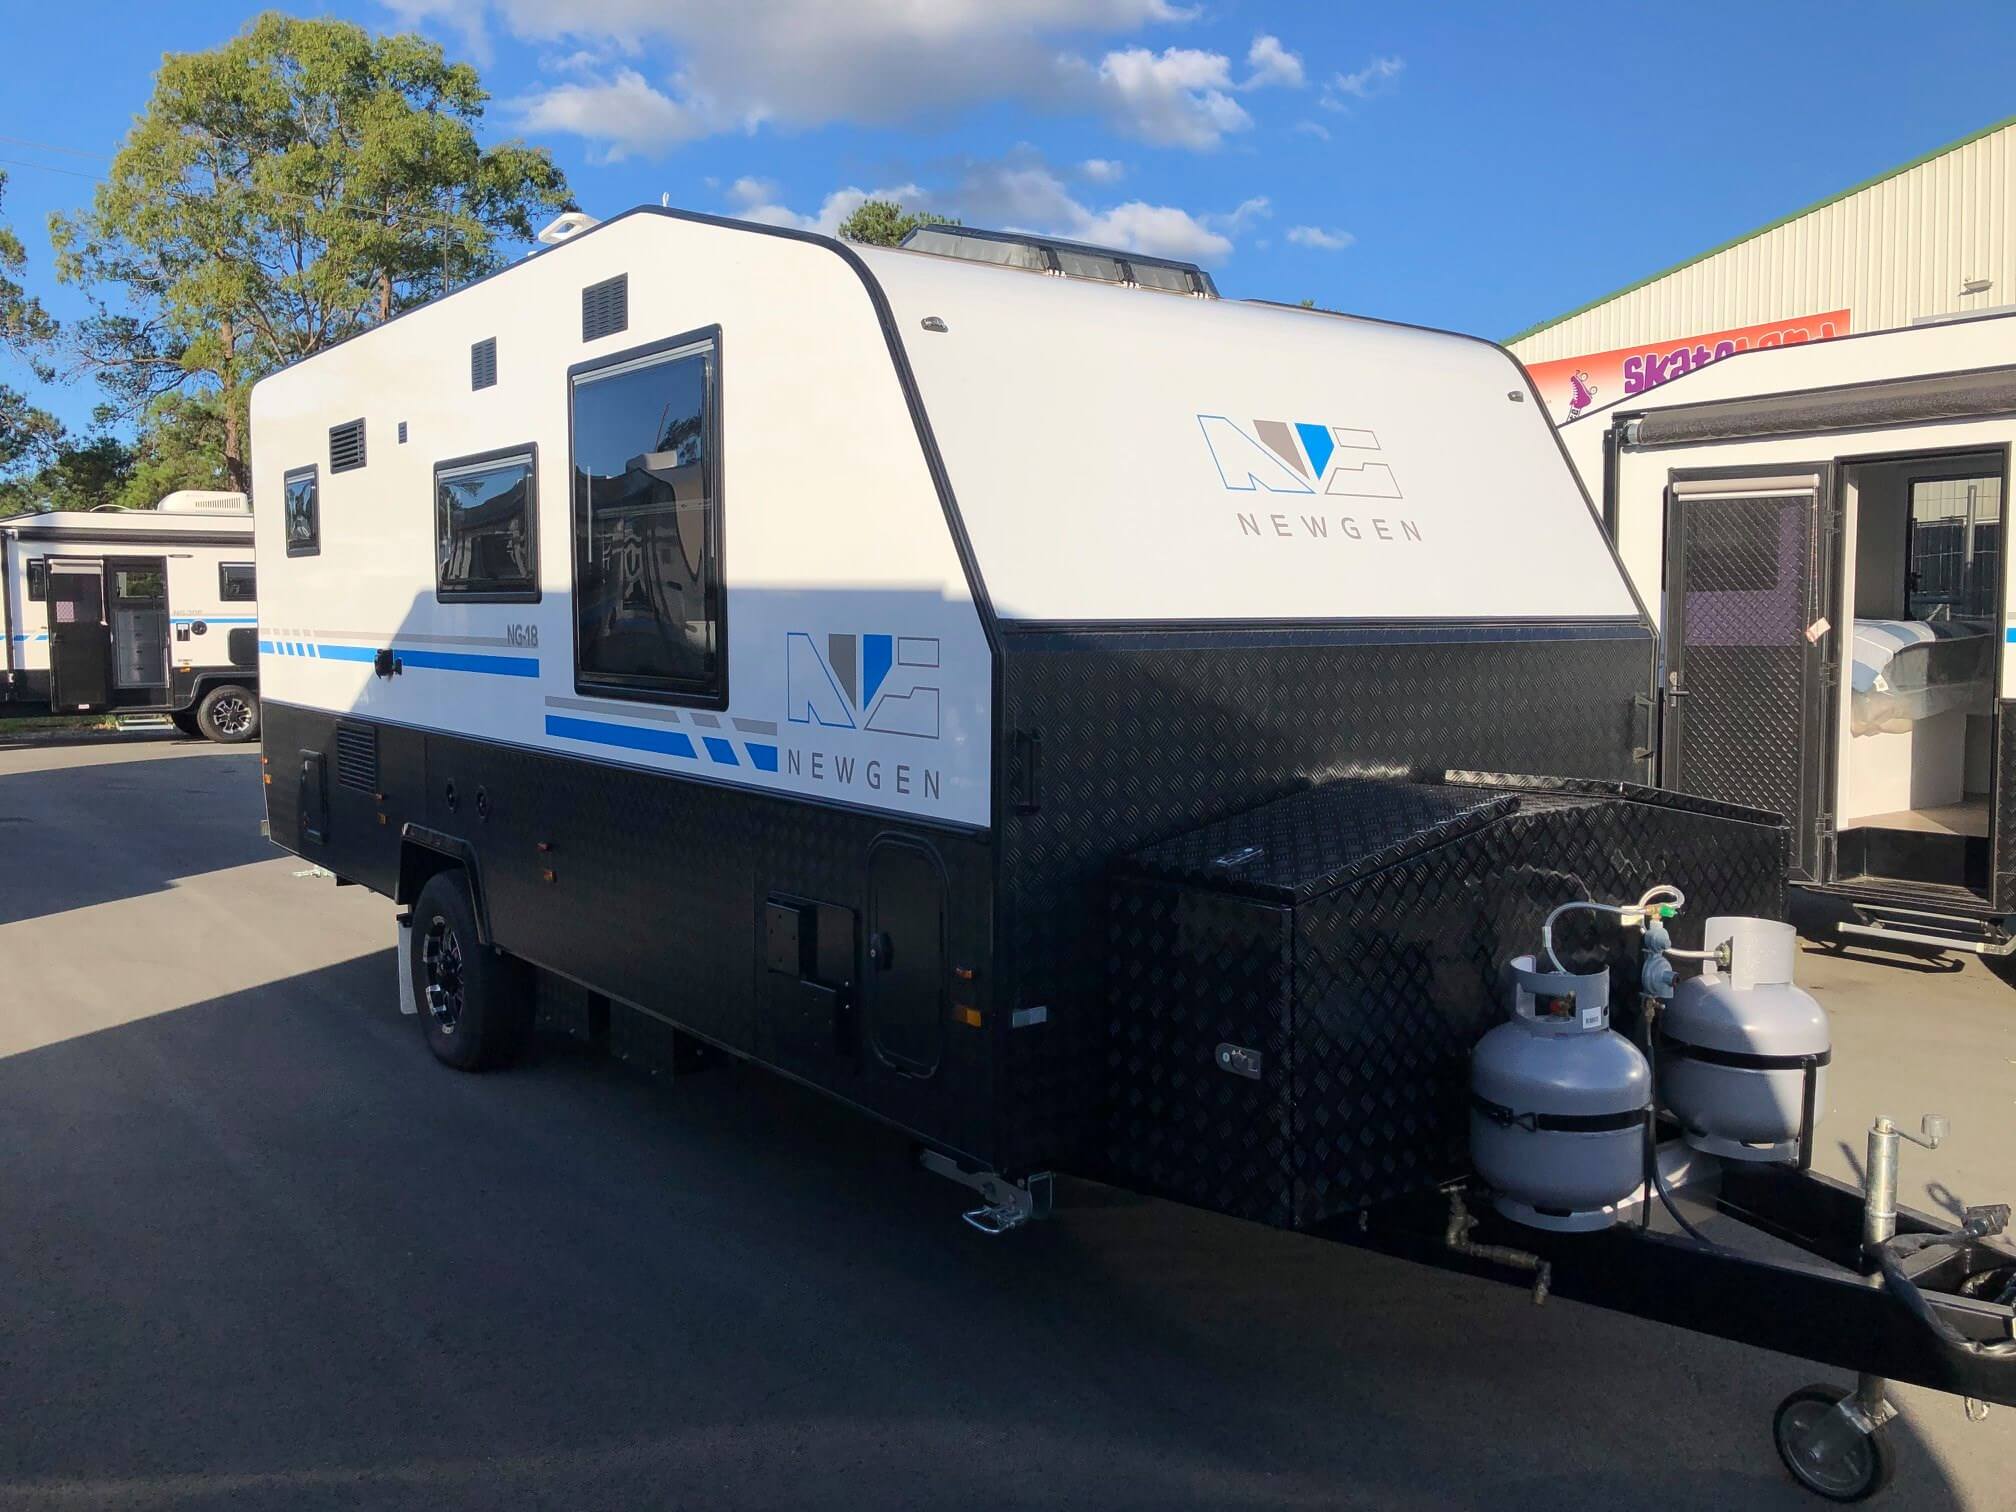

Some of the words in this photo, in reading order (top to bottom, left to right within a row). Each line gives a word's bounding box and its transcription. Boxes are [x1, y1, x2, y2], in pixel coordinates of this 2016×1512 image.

[1237, 512, 1423, 542] NEWGEN
[506, 623, 539, 648] NG-18
[787, 749, 940, 800] NEWGEN
